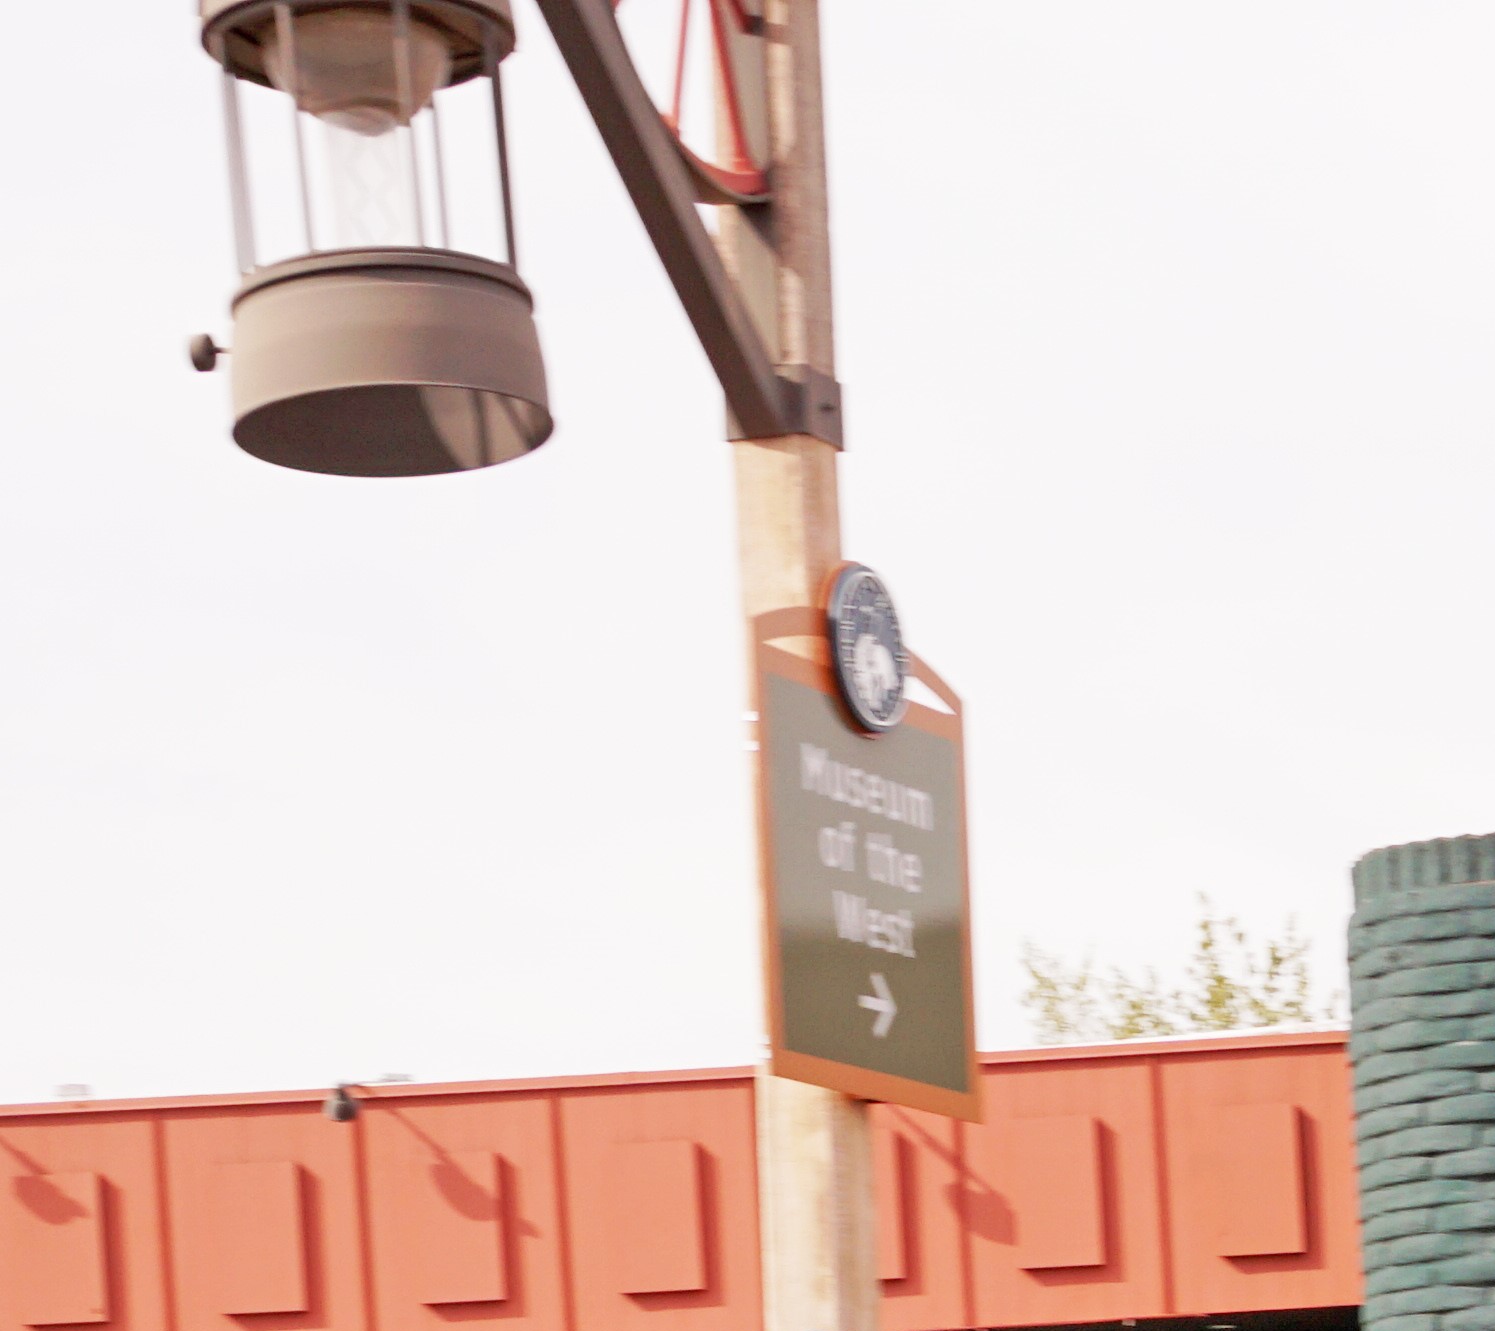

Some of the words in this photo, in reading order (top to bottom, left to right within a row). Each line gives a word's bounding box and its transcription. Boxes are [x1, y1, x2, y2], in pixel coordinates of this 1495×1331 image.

[800, 743, 933, 831] Museum
[819, 820, 856, 871] of
[865, 832, 921, 893] the
[832, 890, 917, 958] West
